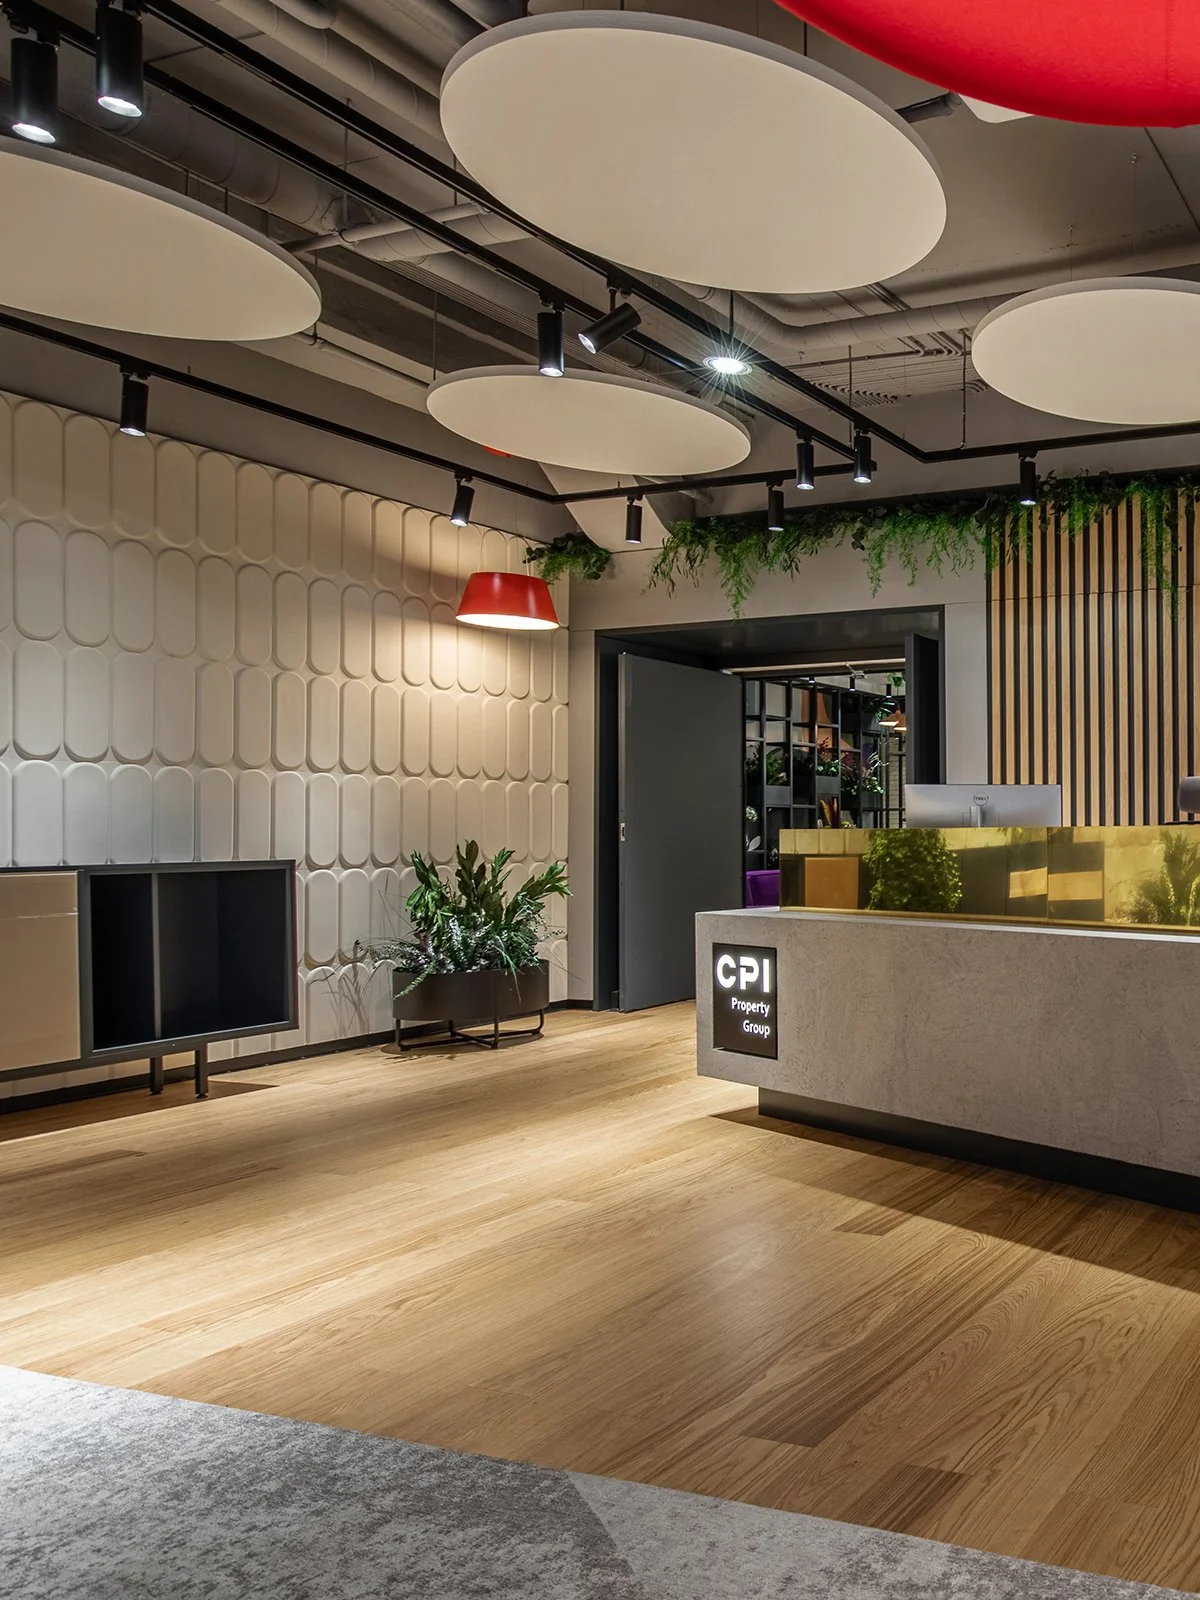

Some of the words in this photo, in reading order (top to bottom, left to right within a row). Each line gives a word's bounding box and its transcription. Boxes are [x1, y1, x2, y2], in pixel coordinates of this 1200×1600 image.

[716, 954, 770, 993] CPI
[731, 997, 770, 1018] Property
[742, 1019, 771, 1038] Group
